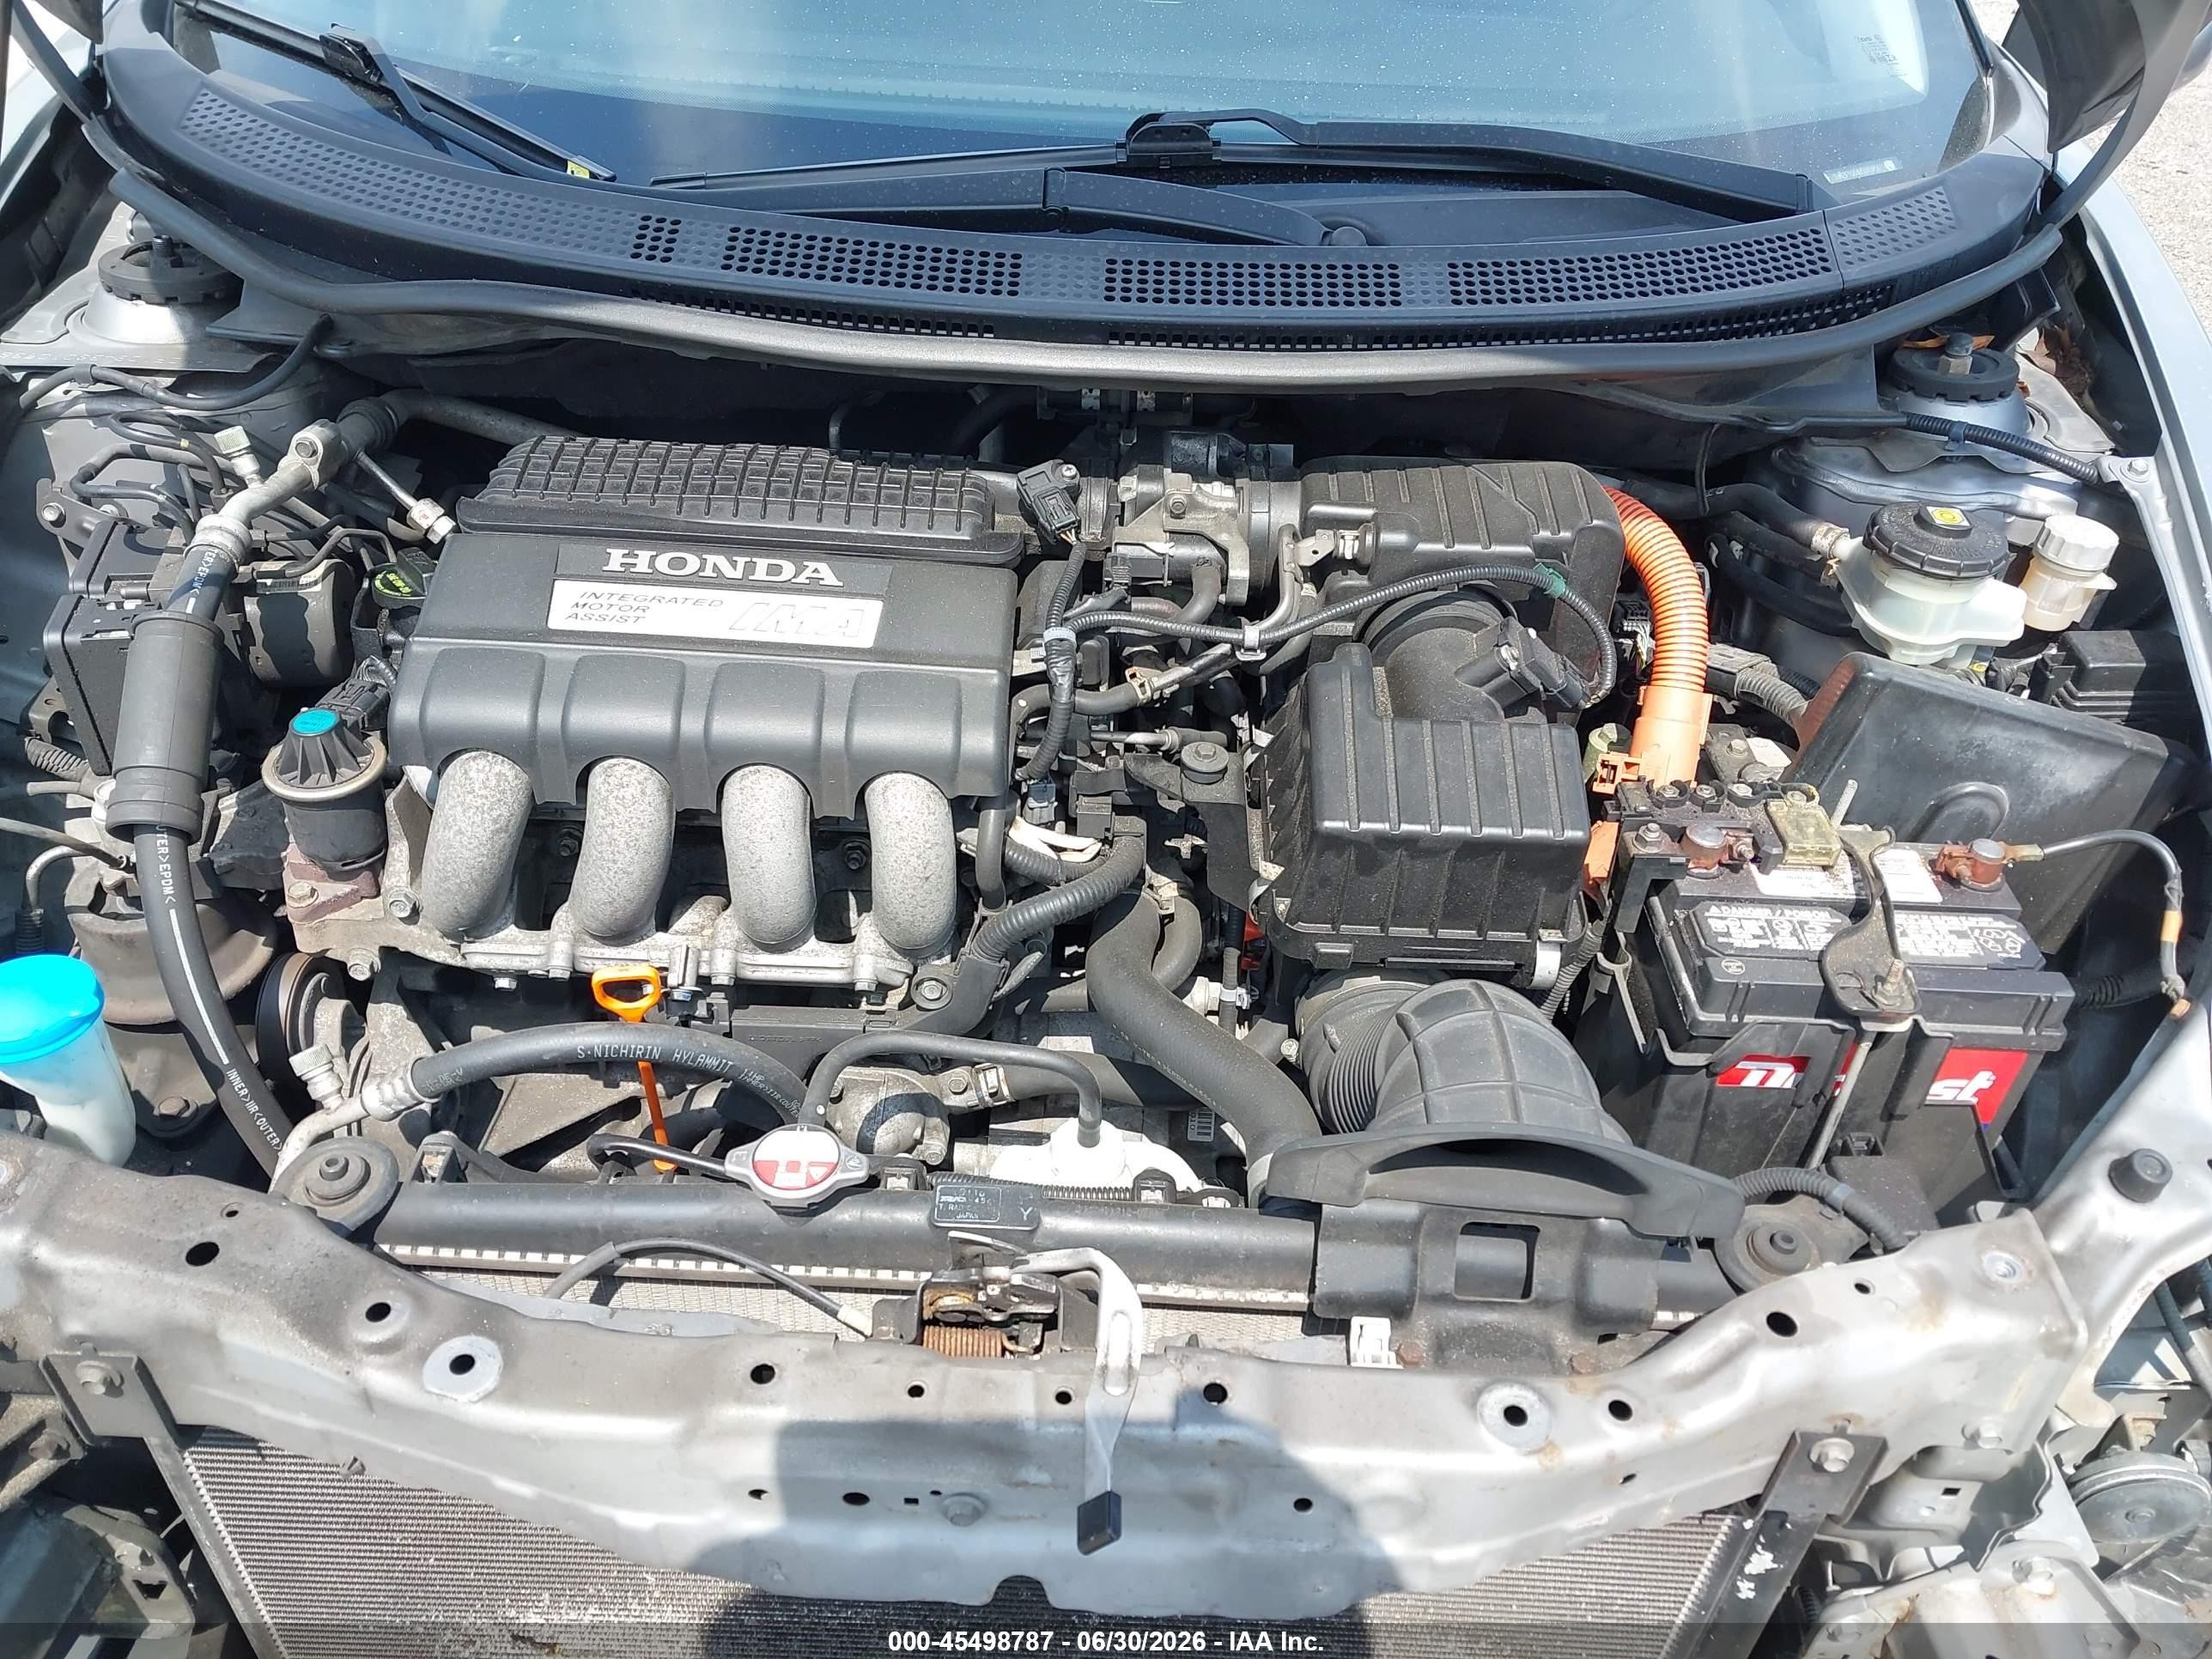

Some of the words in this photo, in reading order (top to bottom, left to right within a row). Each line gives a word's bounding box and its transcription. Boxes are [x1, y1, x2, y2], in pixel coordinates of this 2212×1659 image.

[603, 548, 844, 587] HONDA
[580, 592, 723, 607] INTEGRATED
[571, 602, 650, 613] MOTOR
[565, 612, 646, 624] ASSIST
